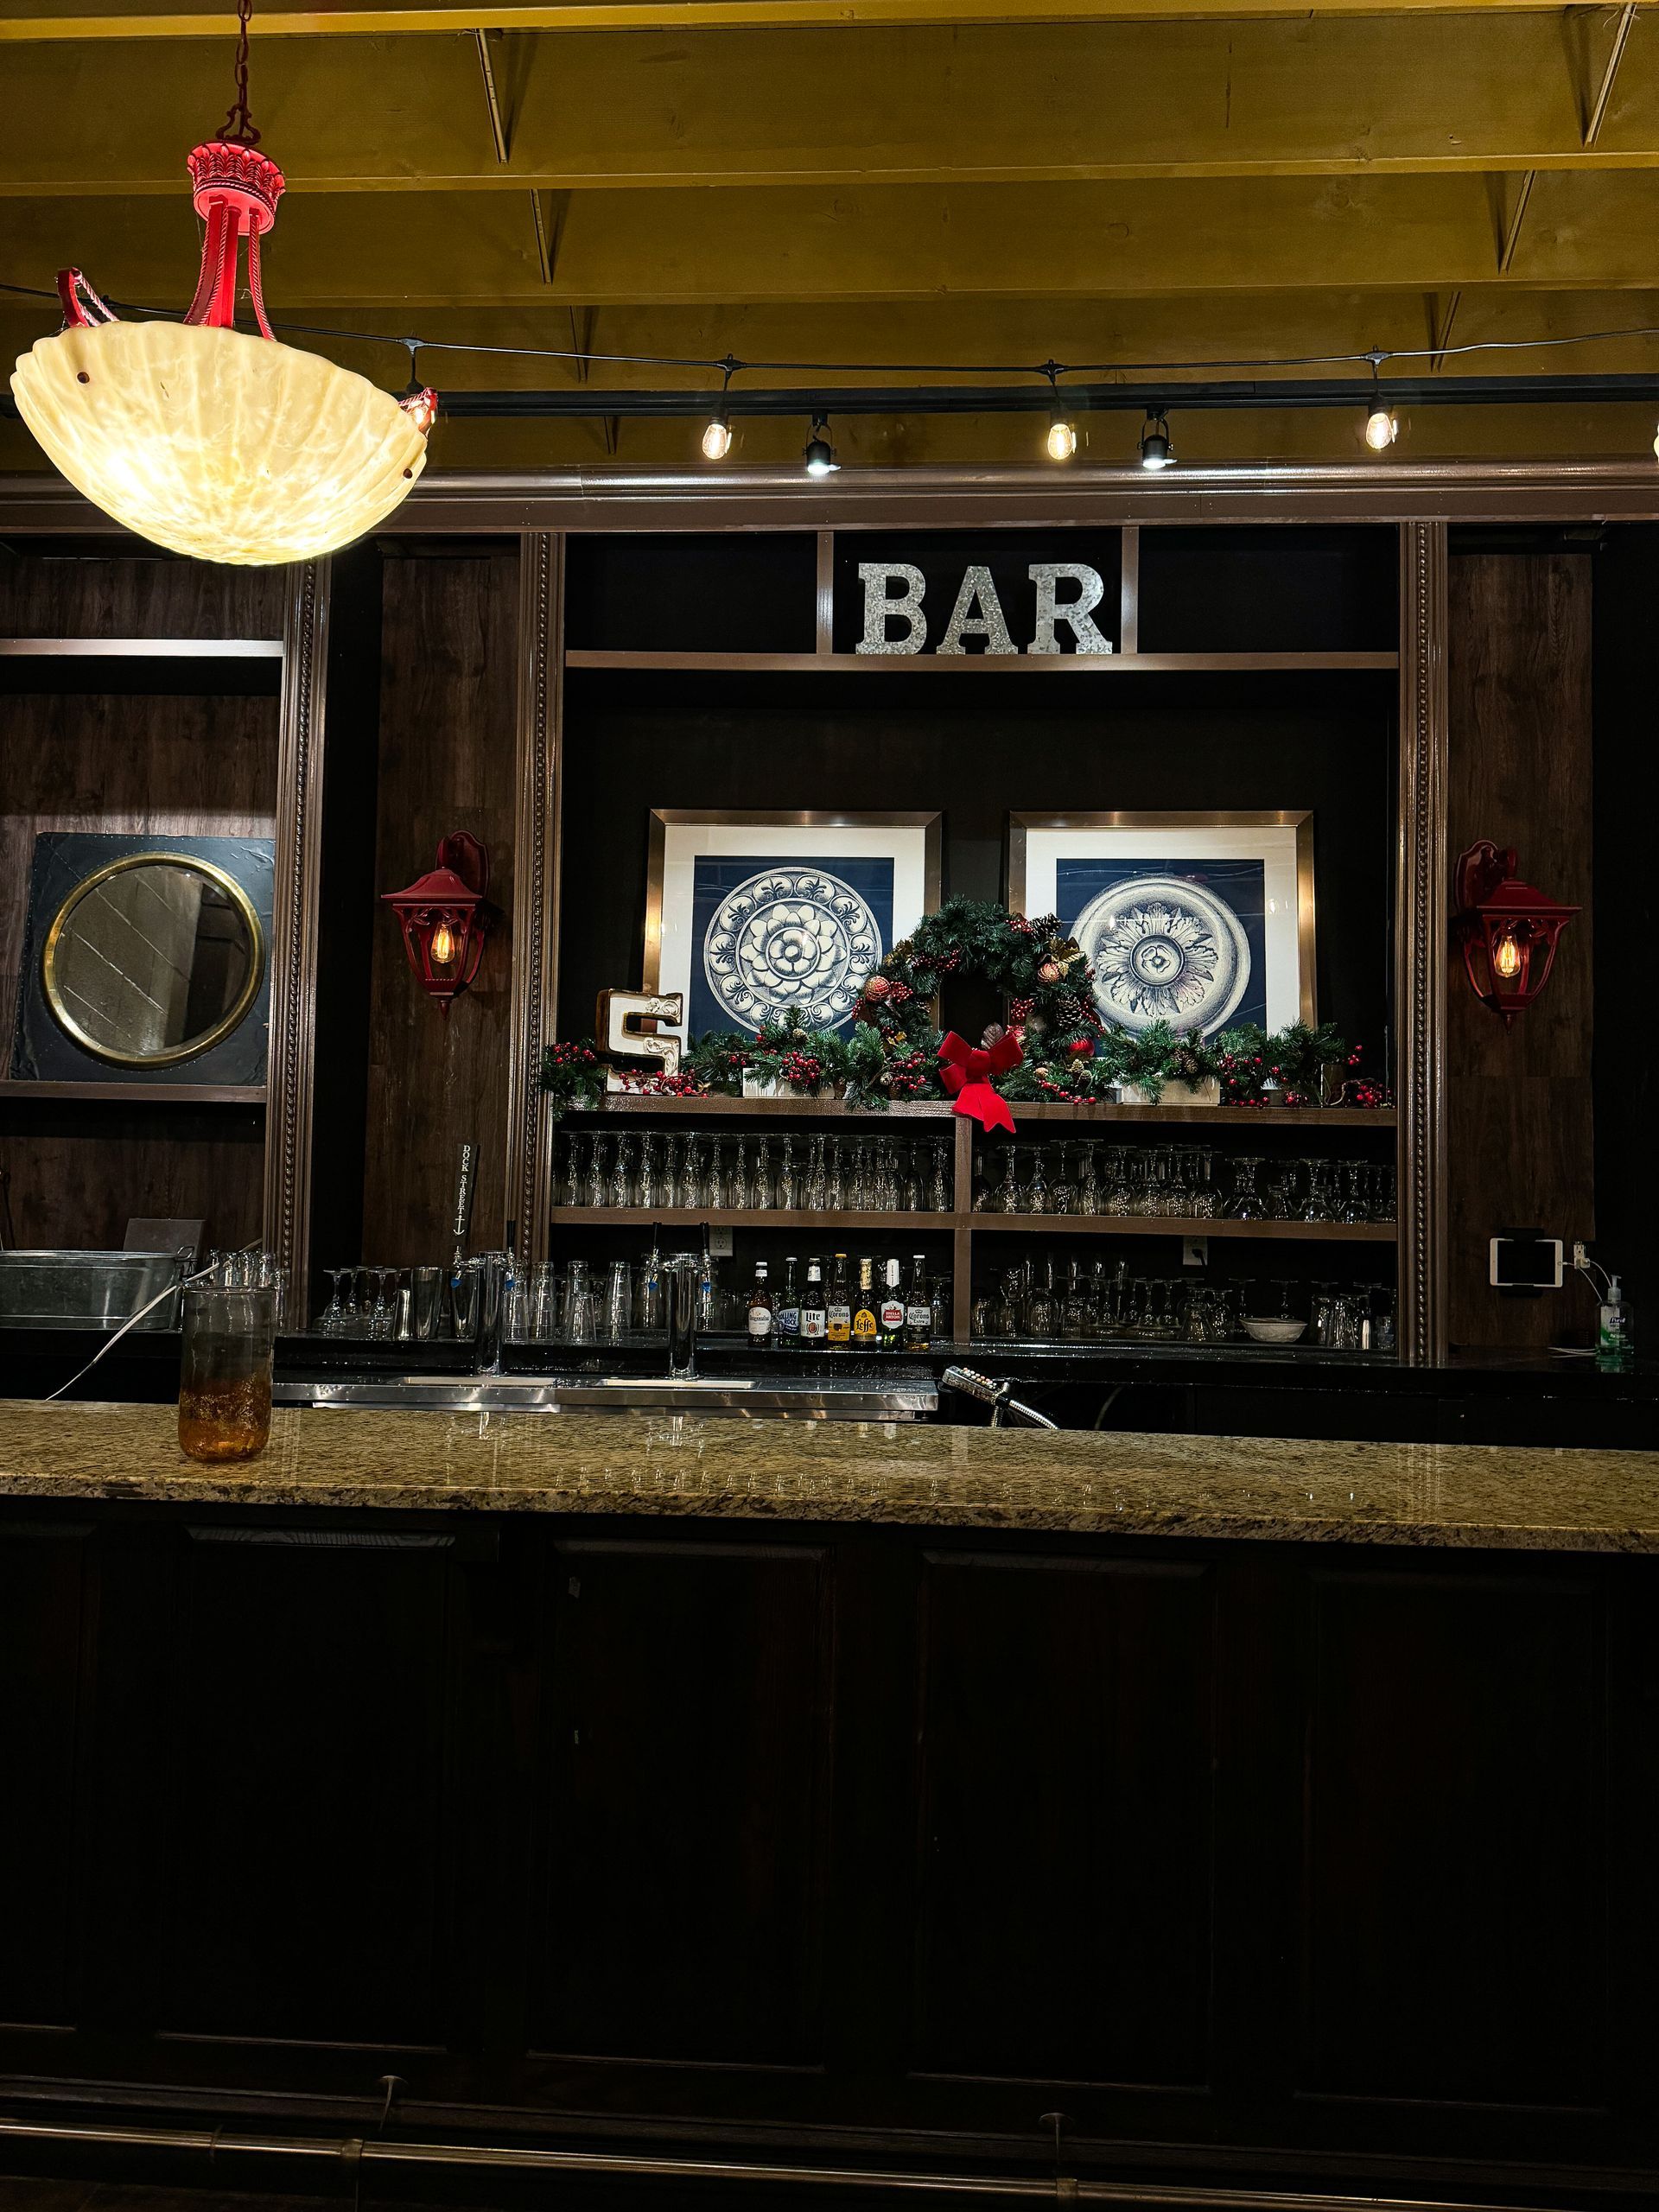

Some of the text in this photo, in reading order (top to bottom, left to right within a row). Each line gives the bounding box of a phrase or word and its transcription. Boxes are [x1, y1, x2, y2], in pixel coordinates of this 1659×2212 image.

[855, 563, 1113, 655] BAR
[457, 1145, 470, 1214] DOCK STREET
[805, 1312, 820, 1321] Lite
